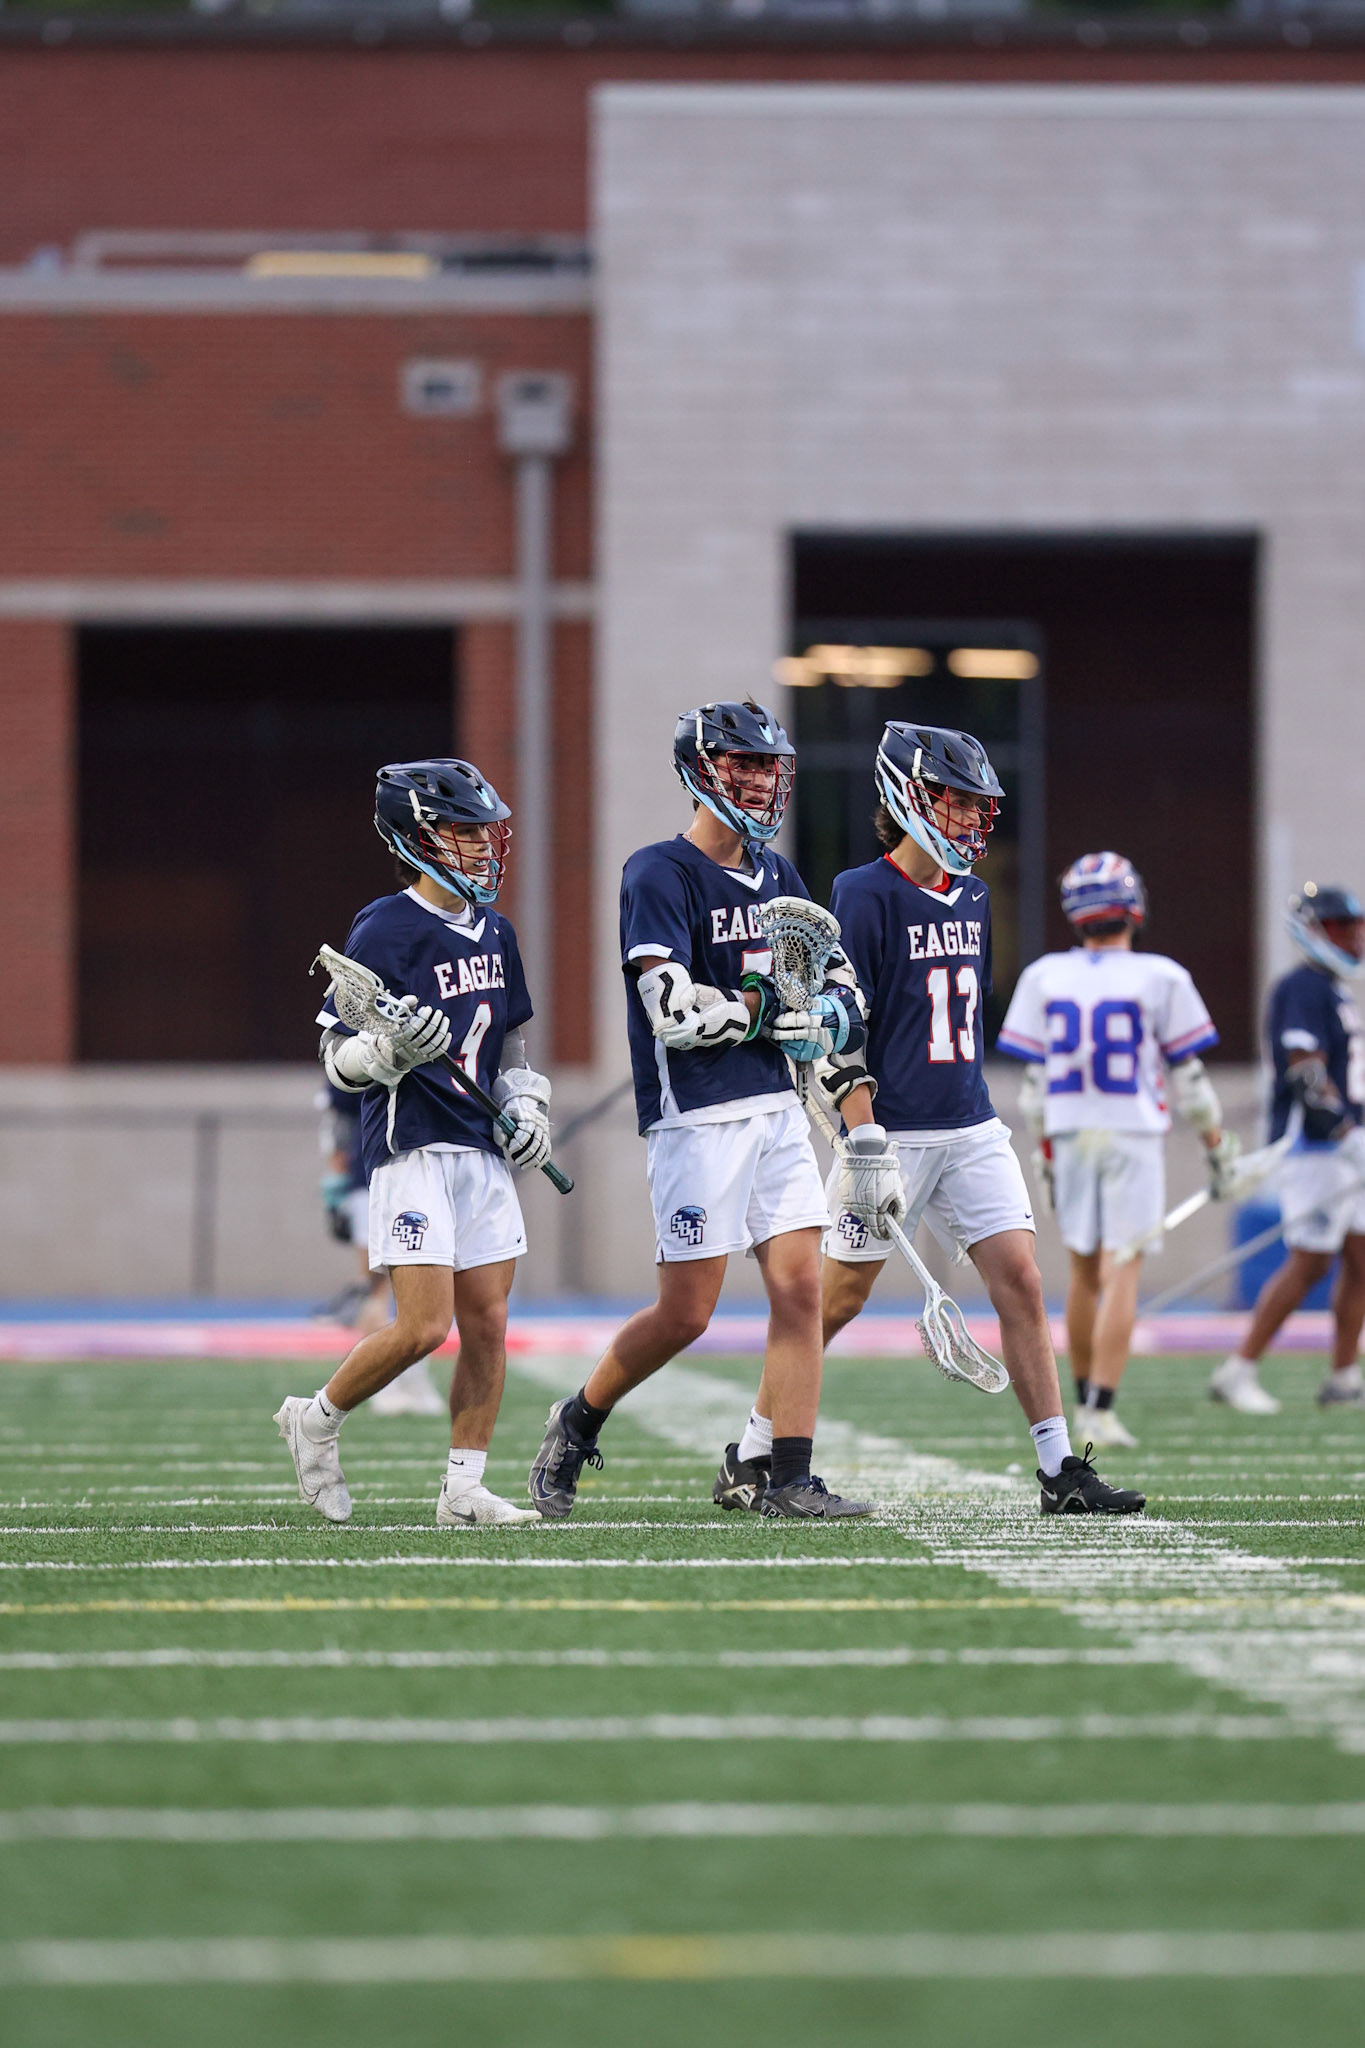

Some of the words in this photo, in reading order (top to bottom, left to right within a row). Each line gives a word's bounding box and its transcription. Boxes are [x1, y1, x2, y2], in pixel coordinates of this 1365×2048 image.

[711, 903, 768, 944] EAG
[907, 920, 981, 960] EAGLES
[926, 965, 978, 1063] 13
[1045, 1000, 1143, 1095] 28
[838, 1215, 868, 1248] SBA
